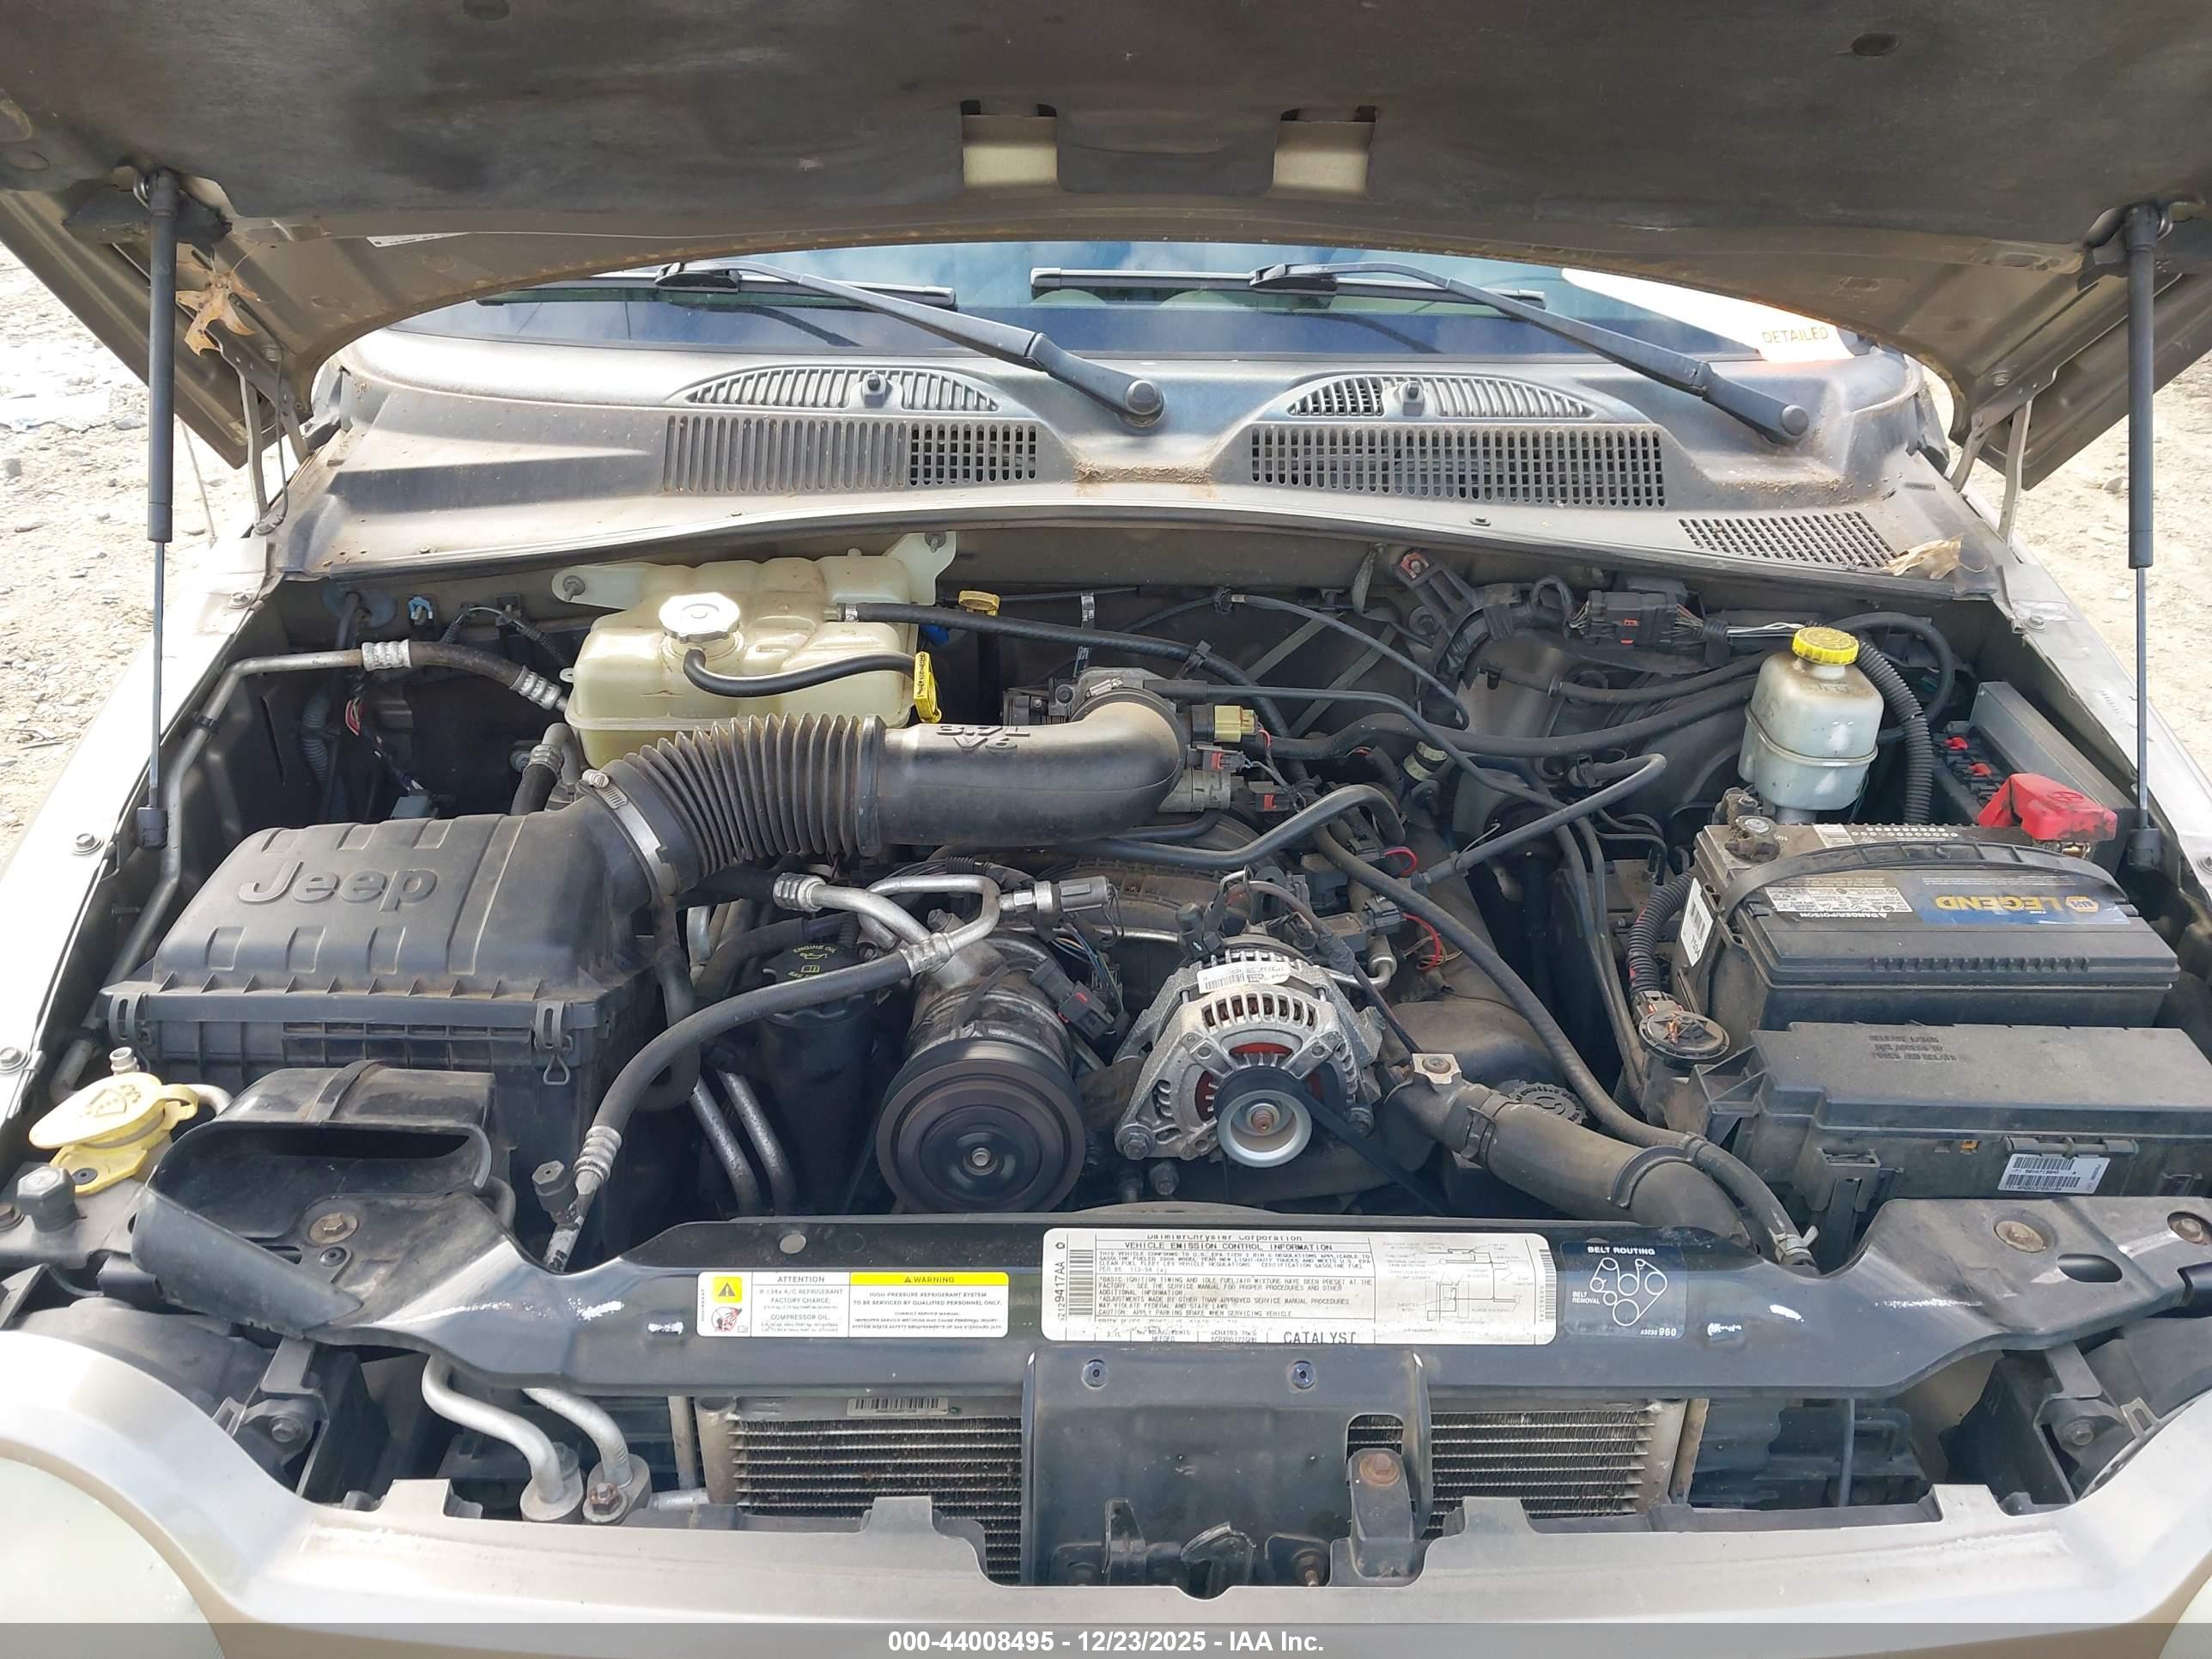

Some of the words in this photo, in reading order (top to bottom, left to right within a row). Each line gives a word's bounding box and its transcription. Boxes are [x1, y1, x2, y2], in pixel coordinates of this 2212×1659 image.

[1761, 326, 1828, 343] DETAILED
[952, 737, 1018, 749] V6
[237, 860, 439, 912] Jeep
[1936, 895, 2063, 910] LEGEND
[793, 945, 824, 953] ENGINE
[1284, 1331, 1356, 1344] CATALYST
